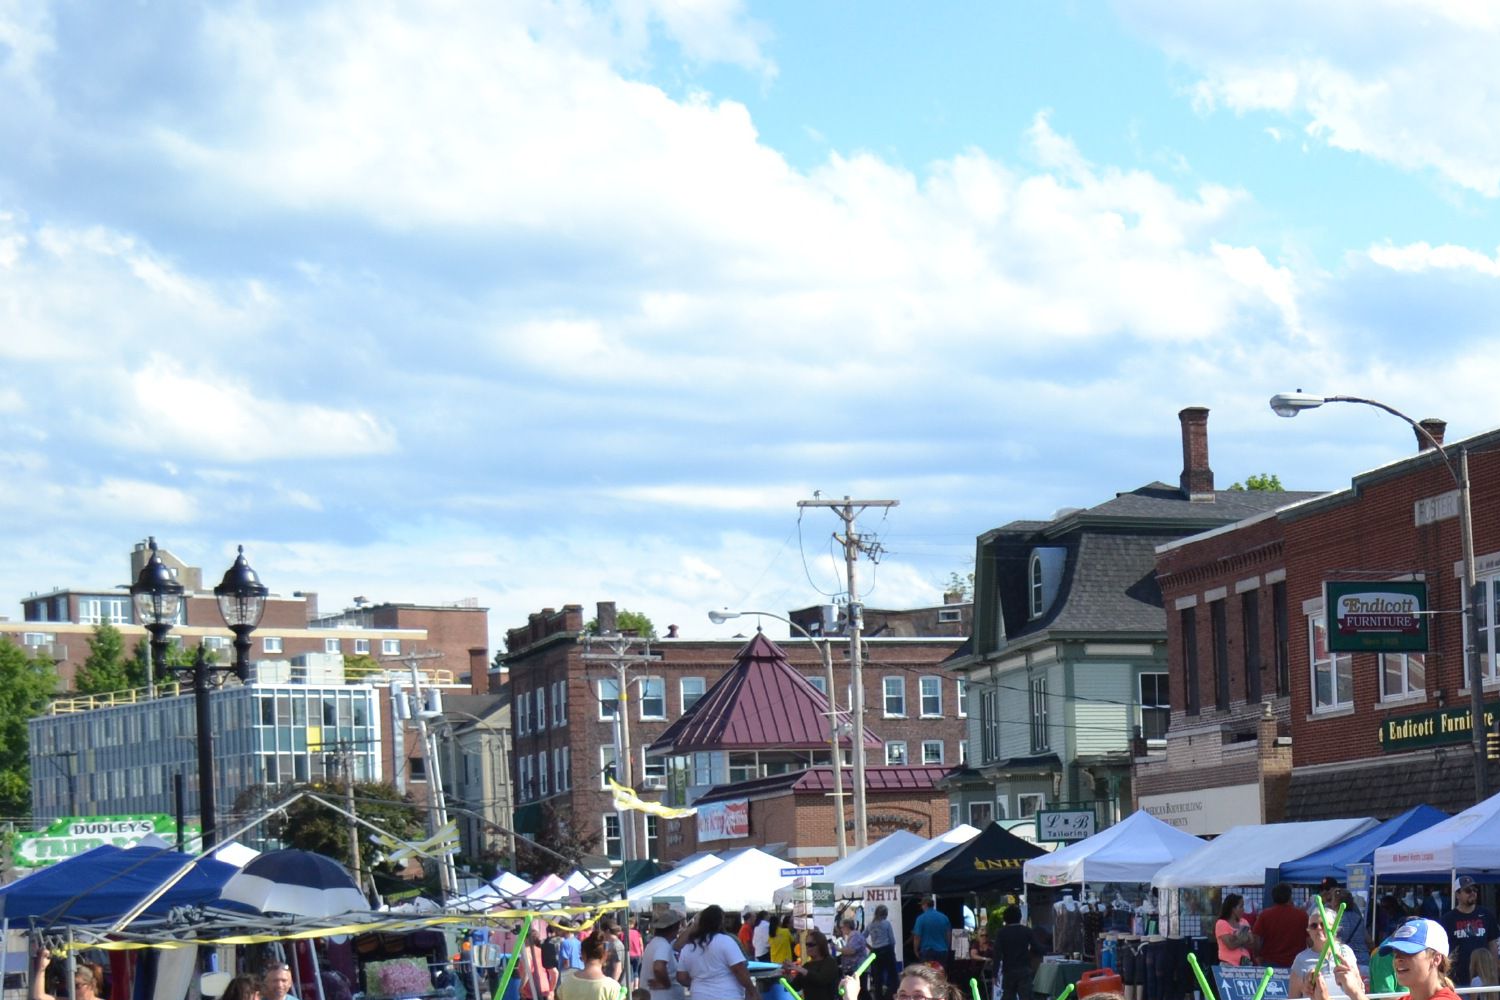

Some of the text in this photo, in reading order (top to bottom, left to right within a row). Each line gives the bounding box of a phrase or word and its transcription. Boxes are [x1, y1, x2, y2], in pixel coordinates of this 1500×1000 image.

[1342, 598, 1414, 613] Endicott
[1346, 616, 1412, 627] FURNITURE
[1389, 709, 1494, 741] Endicott Furnire
[73, 822, 151, 835] DUDLEY'S
[1048, 830, 1088, 838] Tailoring
[866, 889, 898, 901] NHTI
